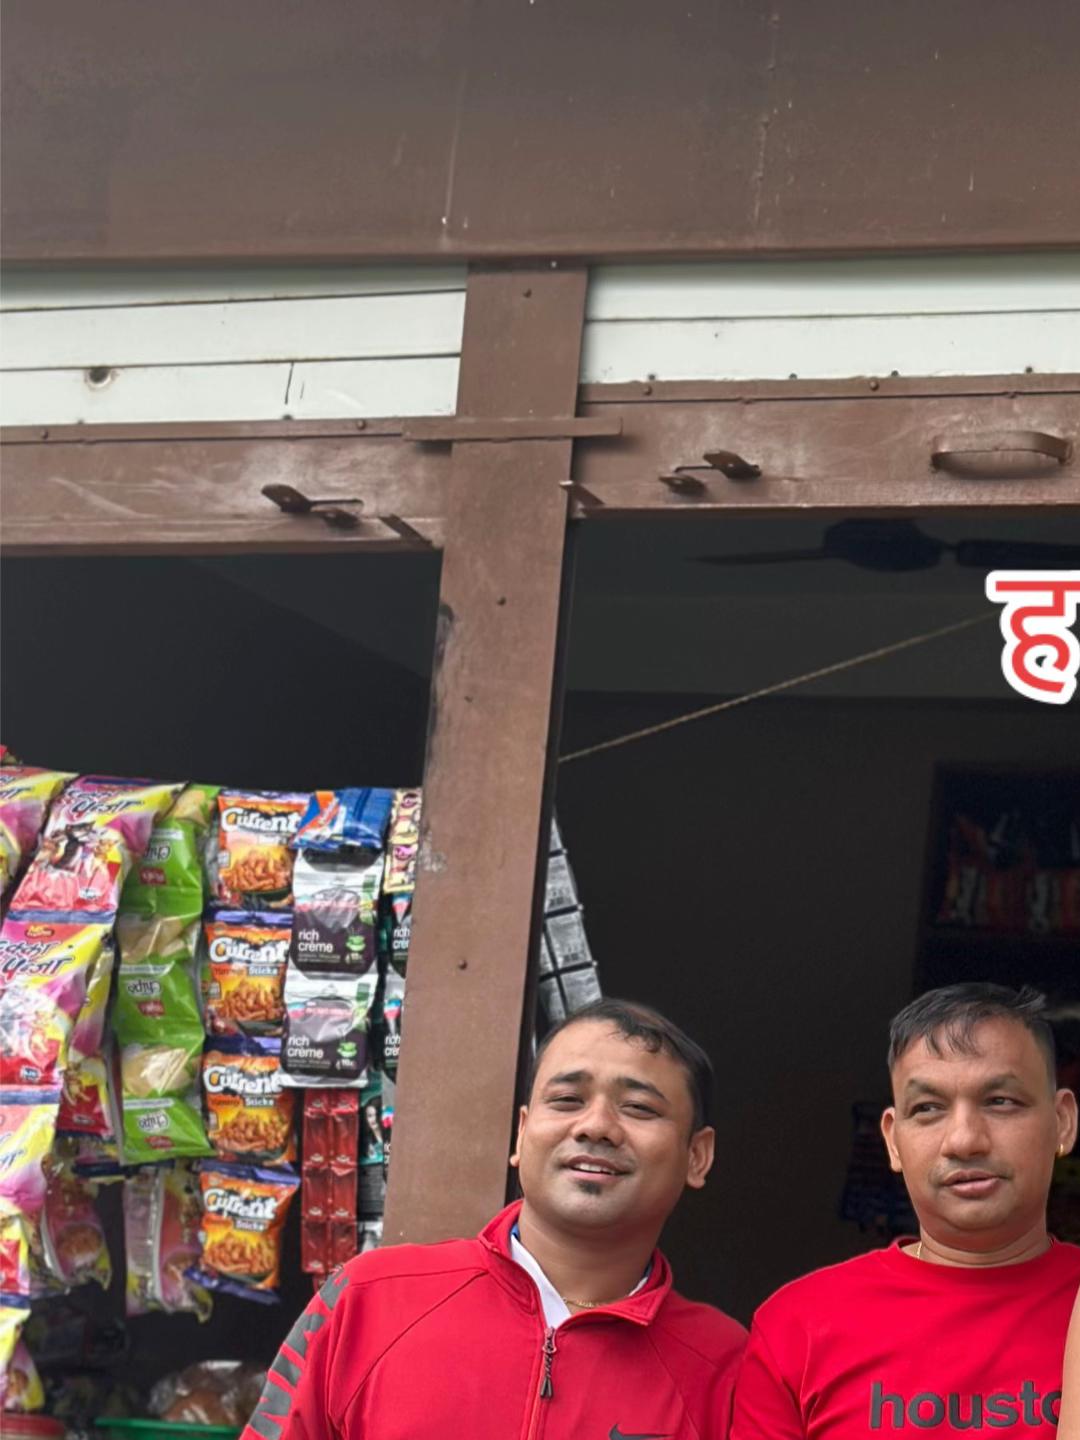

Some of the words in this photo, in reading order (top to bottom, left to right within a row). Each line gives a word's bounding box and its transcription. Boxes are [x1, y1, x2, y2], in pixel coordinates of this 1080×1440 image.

[221, 806, 301, 833] Current
[298, 929, 319, 941] rich
[209, 936, 290, 963] Current
[288, 1035, 310, 1045] rich
[203, 1064, 282, 1093] Current
[204, 1188, 278, 1219] Current
